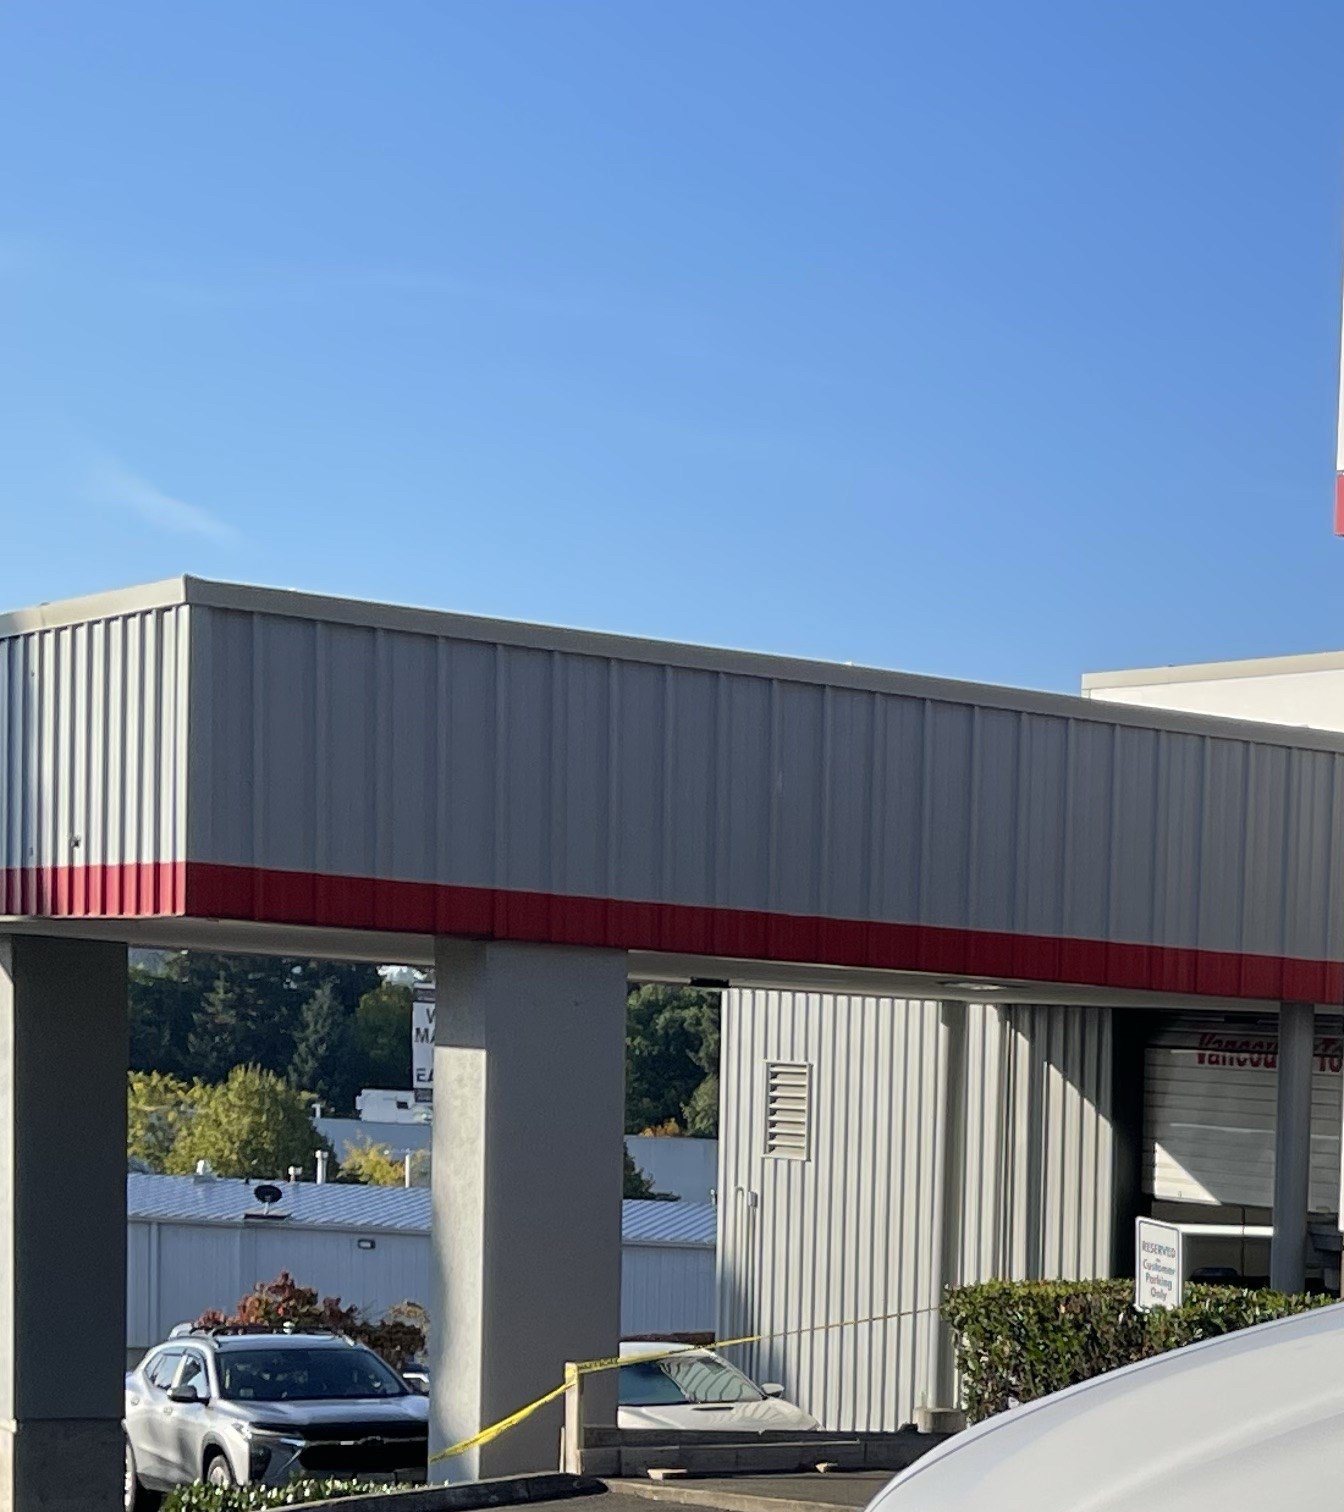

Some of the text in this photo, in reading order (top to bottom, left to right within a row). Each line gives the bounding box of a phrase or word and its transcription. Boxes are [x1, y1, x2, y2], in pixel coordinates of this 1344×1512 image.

[1142, 1240, 1176, 1258] RESERVED
[1145, 1272, 1173, 1291] Parking
[1150, 1286, 1168, 1302] Only
